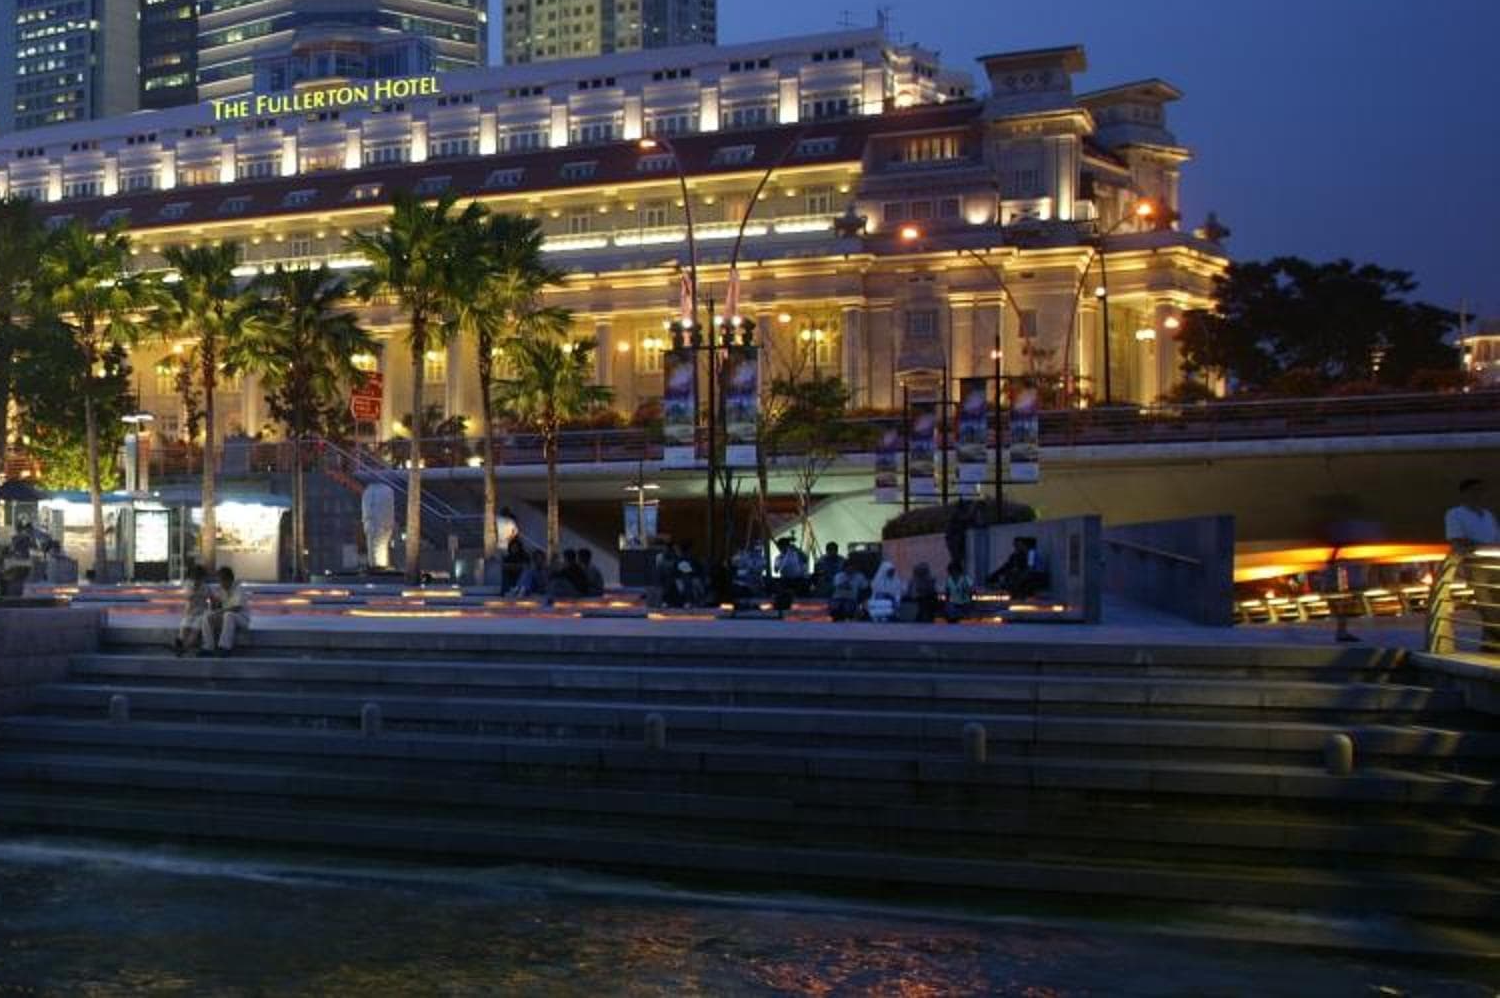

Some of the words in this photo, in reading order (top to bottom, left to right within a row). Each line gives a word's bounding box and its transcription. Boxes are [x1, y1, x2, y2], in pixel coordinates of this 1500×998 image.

[214, 99, 249, 121] THE
[256, 85, 369, 116] FULLERTON
[375, 76, 441, 101] HOTEL
